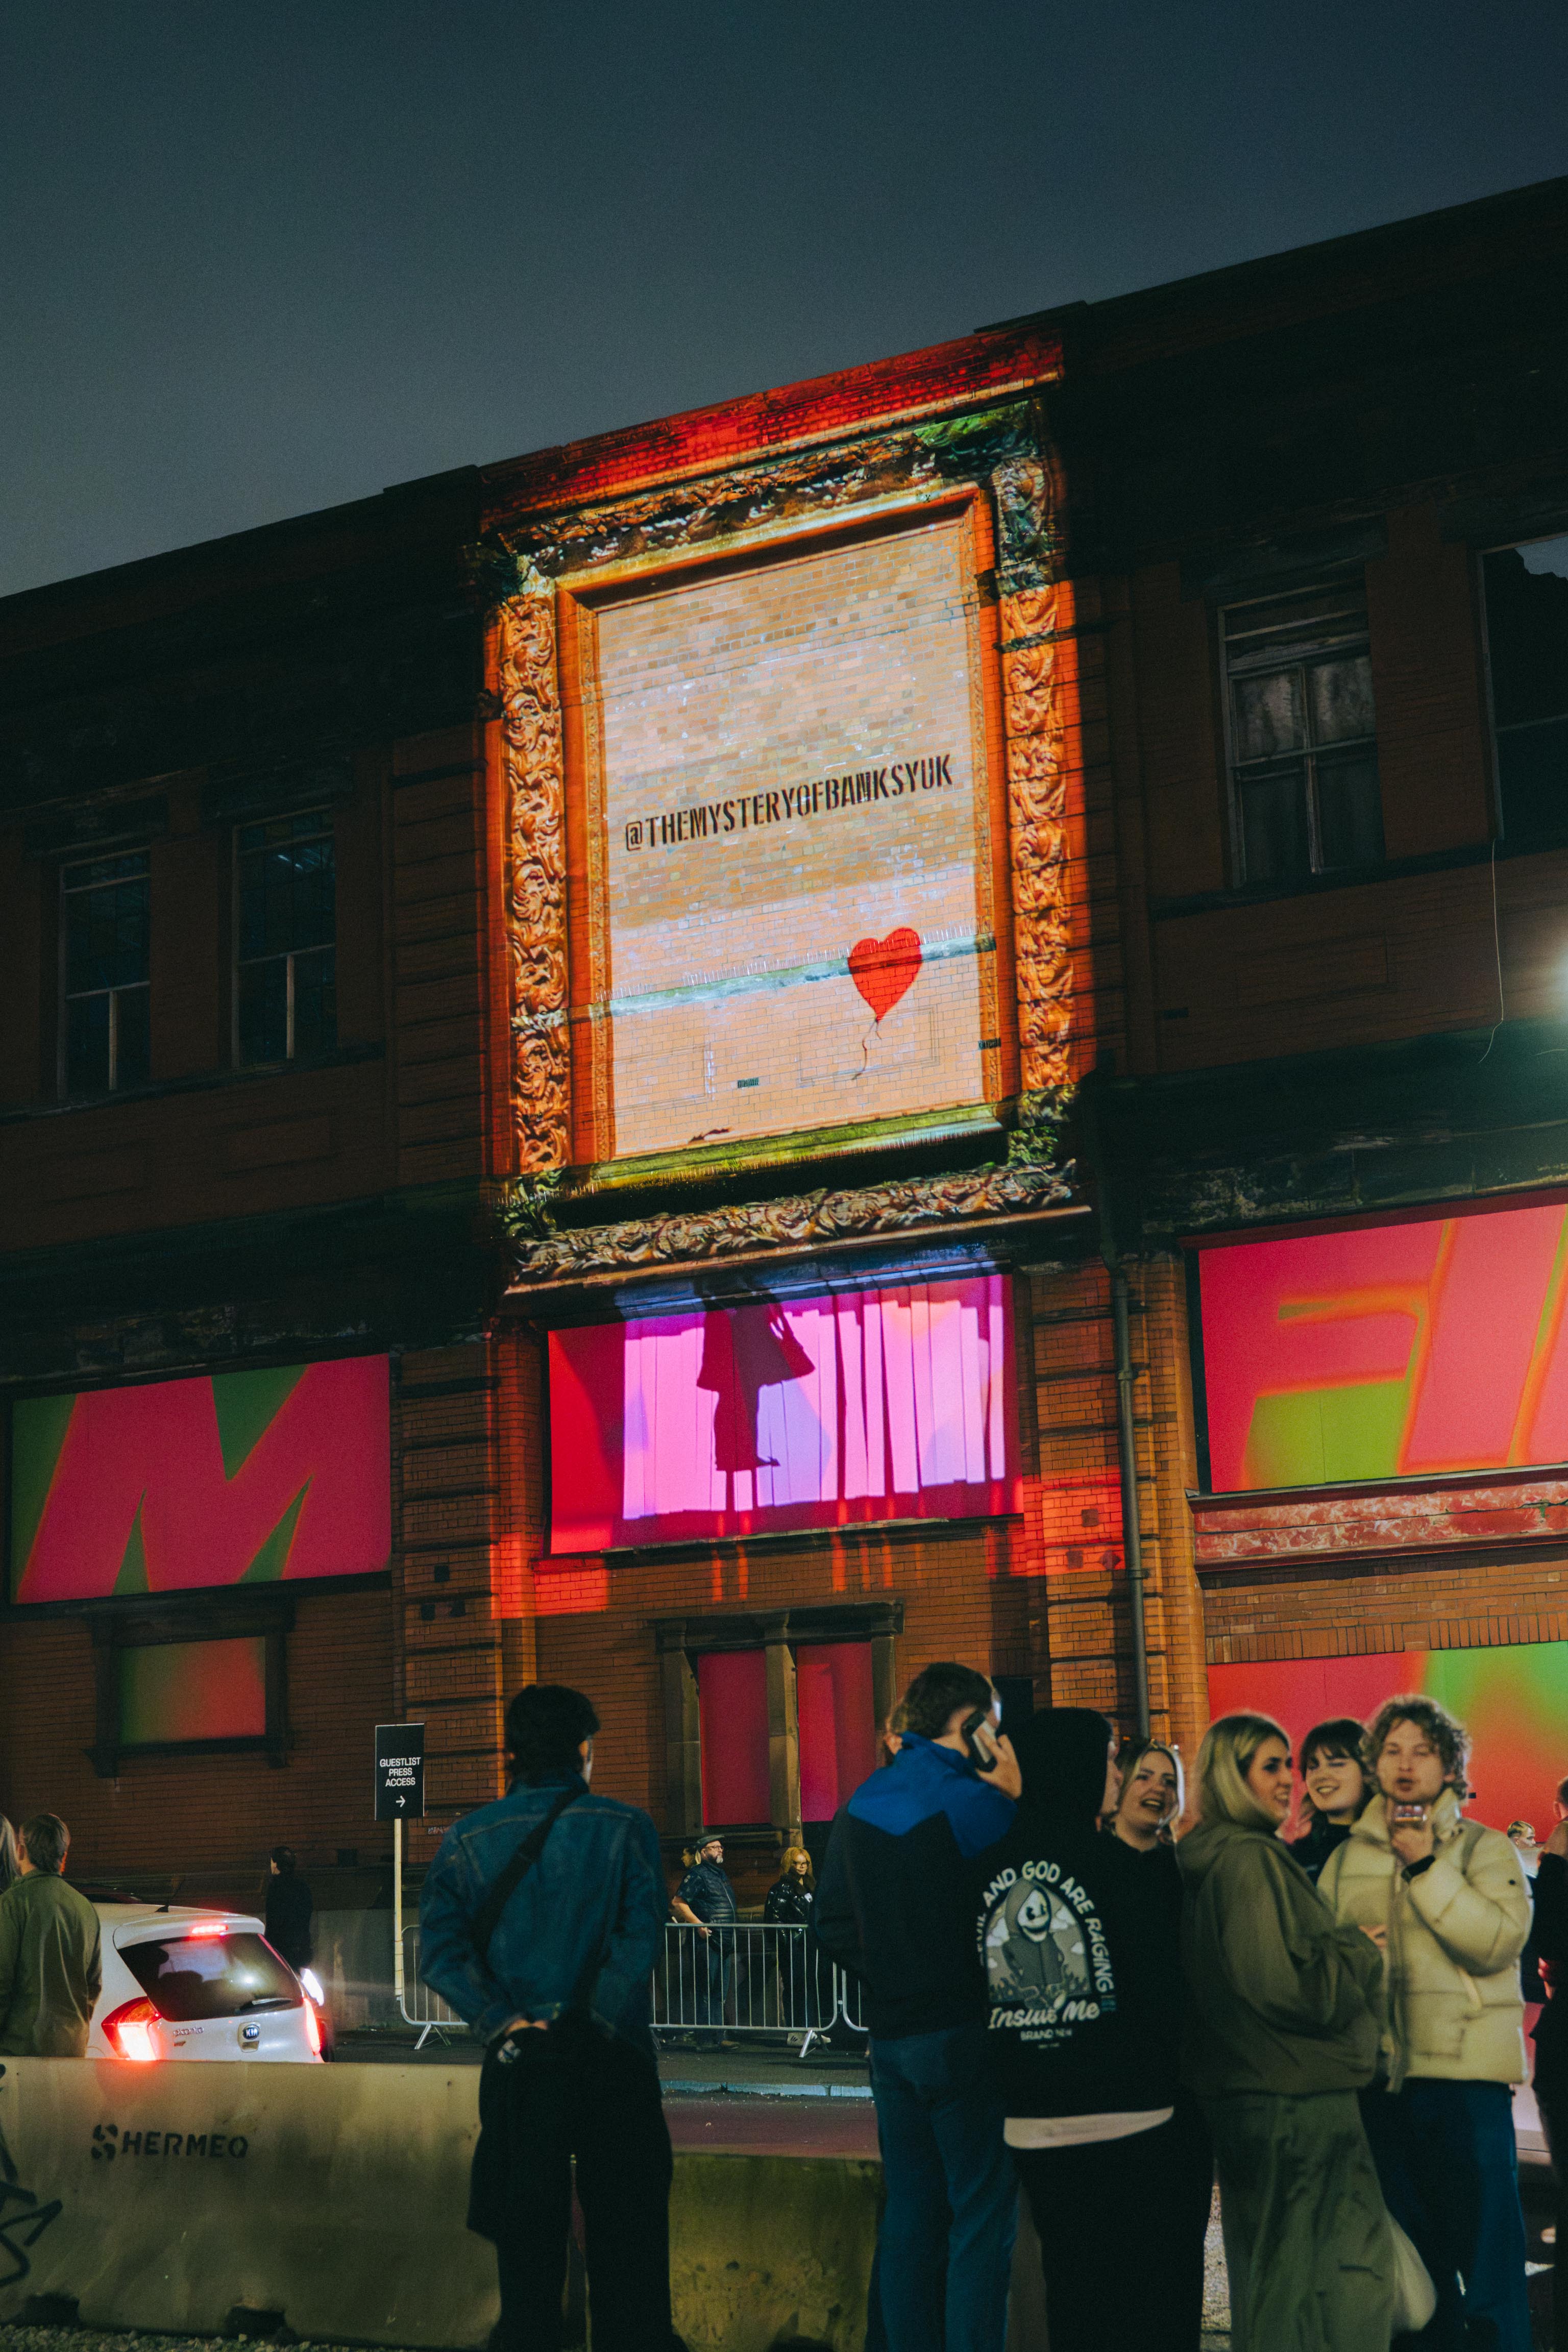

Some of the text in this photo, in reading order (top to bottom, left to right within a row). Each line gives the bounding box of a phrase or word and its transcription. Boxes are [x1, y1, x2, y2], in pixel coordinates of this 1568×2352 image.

[625, 754, 952, 851] @THEMYSTERYOFBANKSYUK
[379, 1757, 421, 1767] GUESTLIST
[388, 1768, 412, 1776] PRESS
[385, 1777, 416, 1787] ACCESS
[982, 1867, 1017, 1908] AND
[1021, 1860, 1061, 1883] GOD
[1060, 1876, 1095, 1915] ARE
[1085, 1917, 1115, 1993] RAGING
